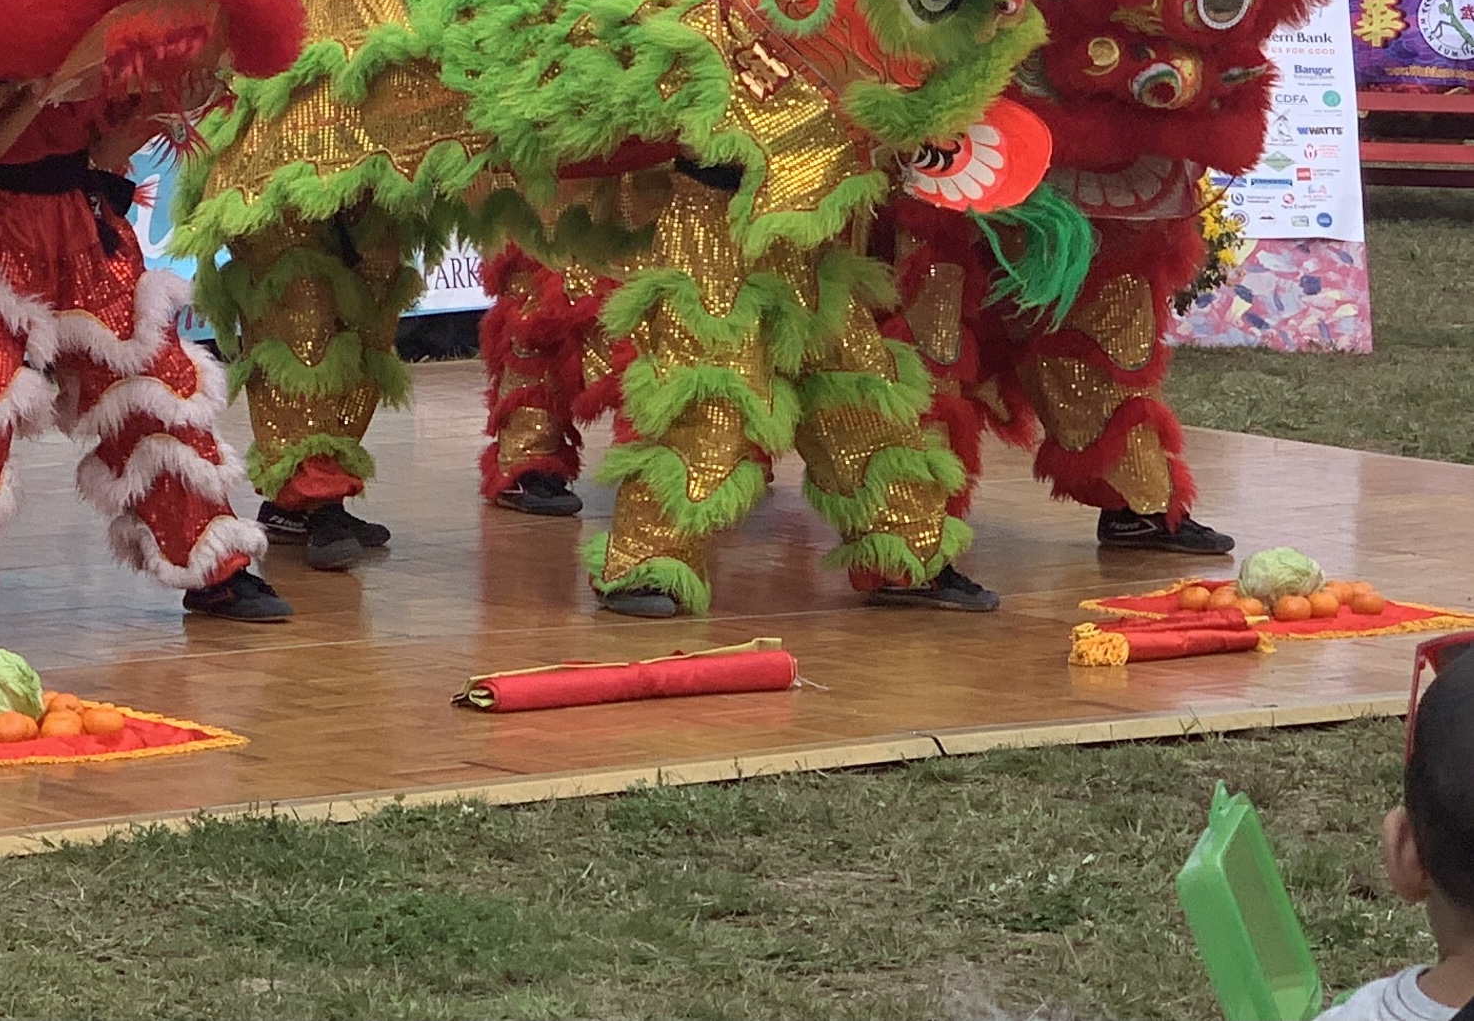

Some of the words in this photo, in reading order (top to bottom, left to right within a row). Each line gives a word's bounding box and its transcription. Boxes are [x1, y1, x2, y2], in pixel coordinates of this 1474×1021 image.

[1269, 33, 1294, 43] ern
[1297, 32, 1332, 43] Bank
[1294, 64, 1333, 76] Bangor
[1275, 94, 1308, 104] CDFA
[1308, 126, 1344, 135] WATTS
